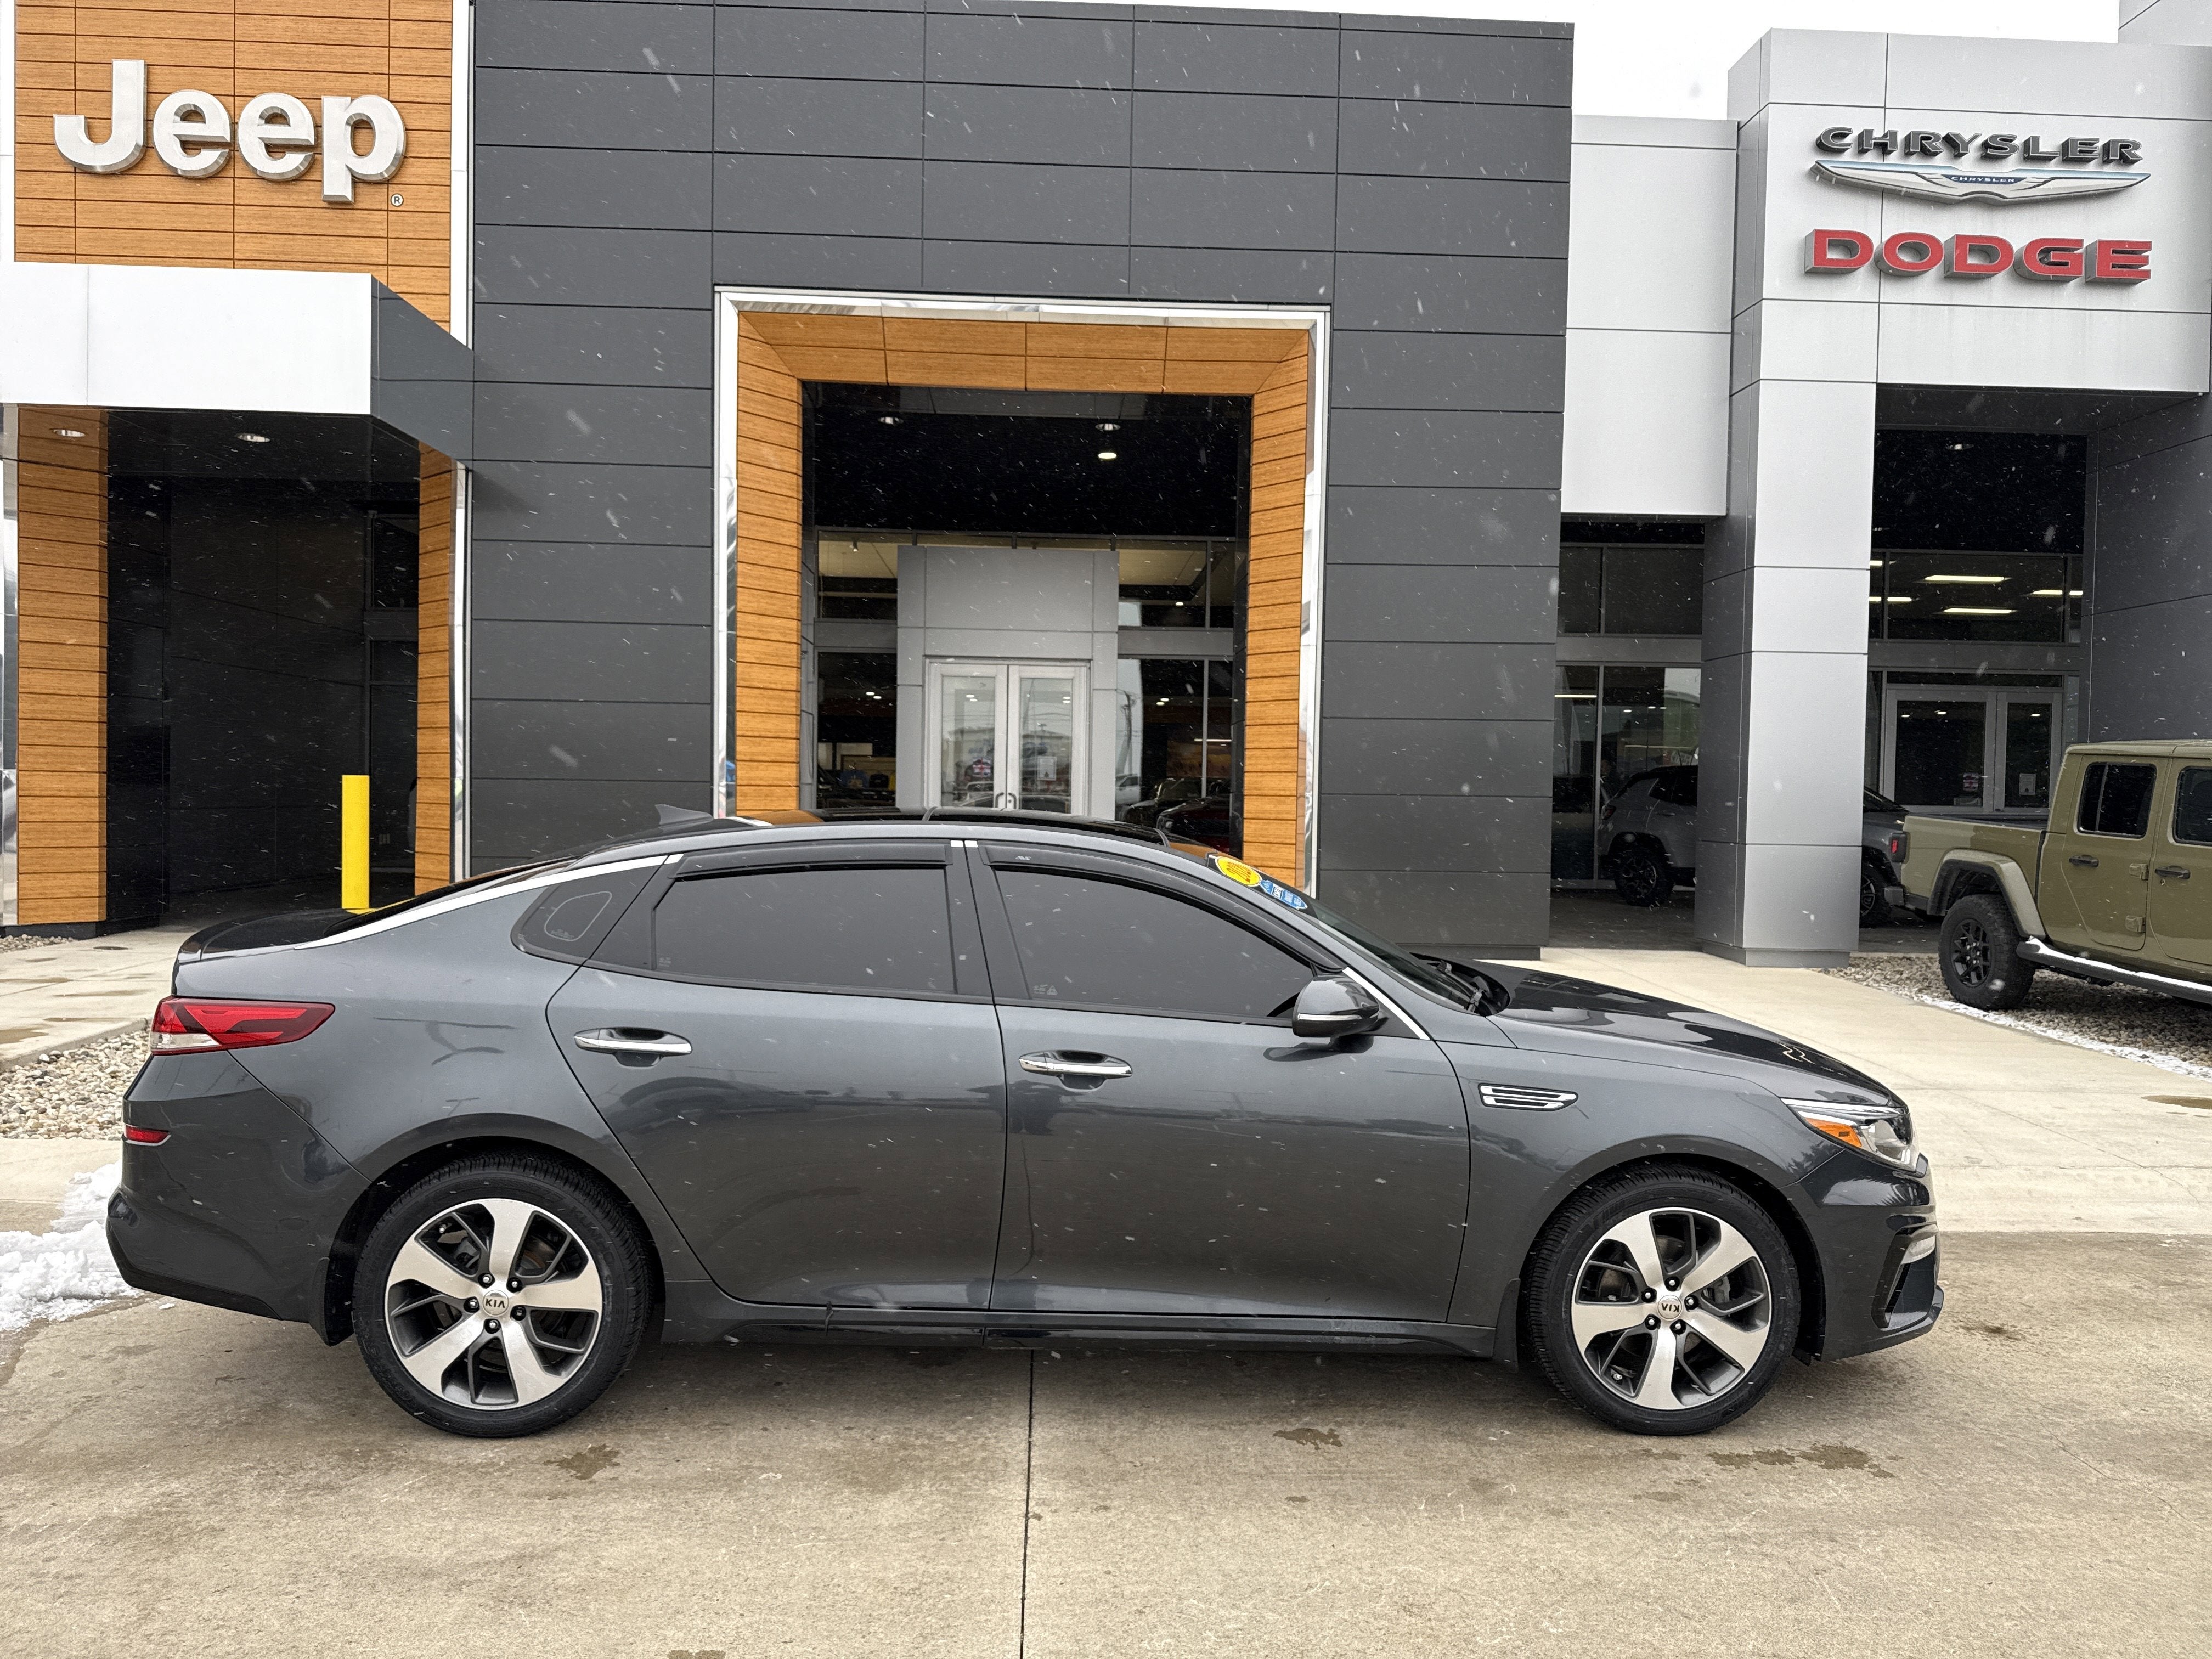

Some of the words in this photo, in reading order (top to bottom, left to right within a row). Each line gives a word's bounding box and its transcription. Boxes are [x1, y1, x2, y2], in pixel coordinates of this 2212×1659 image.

[53, 59, 407, 204] Jeep
[1816, 127, 2143, 163] CHRYSLER
[1804, 228, 2152, 284] DODGE
[485, 1298, 505, 1308] KIA
[1661, 1303, 1679, 1312] KIA
